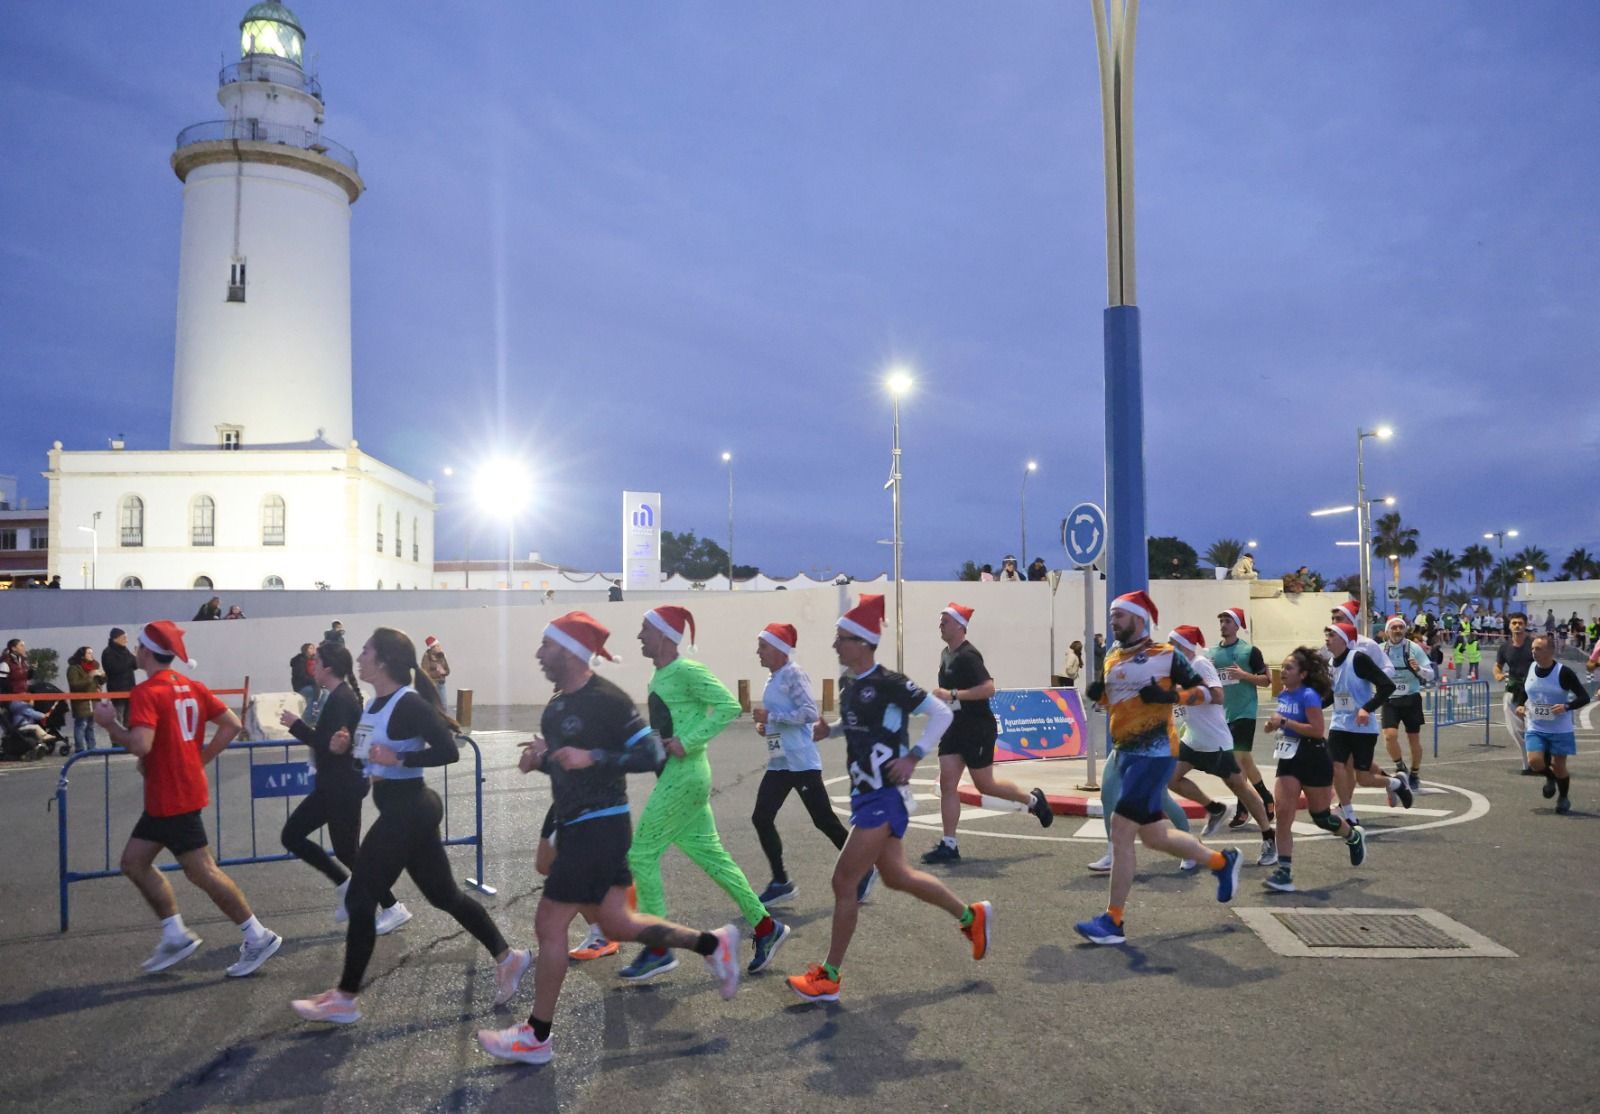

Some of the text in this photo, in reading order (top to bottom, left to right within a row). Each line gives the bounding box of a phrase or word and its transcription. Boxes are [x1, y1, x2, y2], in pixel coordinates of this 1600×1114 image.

[1535, 707, 1550, 715] 823
[175, 698, 199, 741] 10
[1005, 717, 1045, 727] Ayuntamiento
[1046, 716, 1054, 724] de
